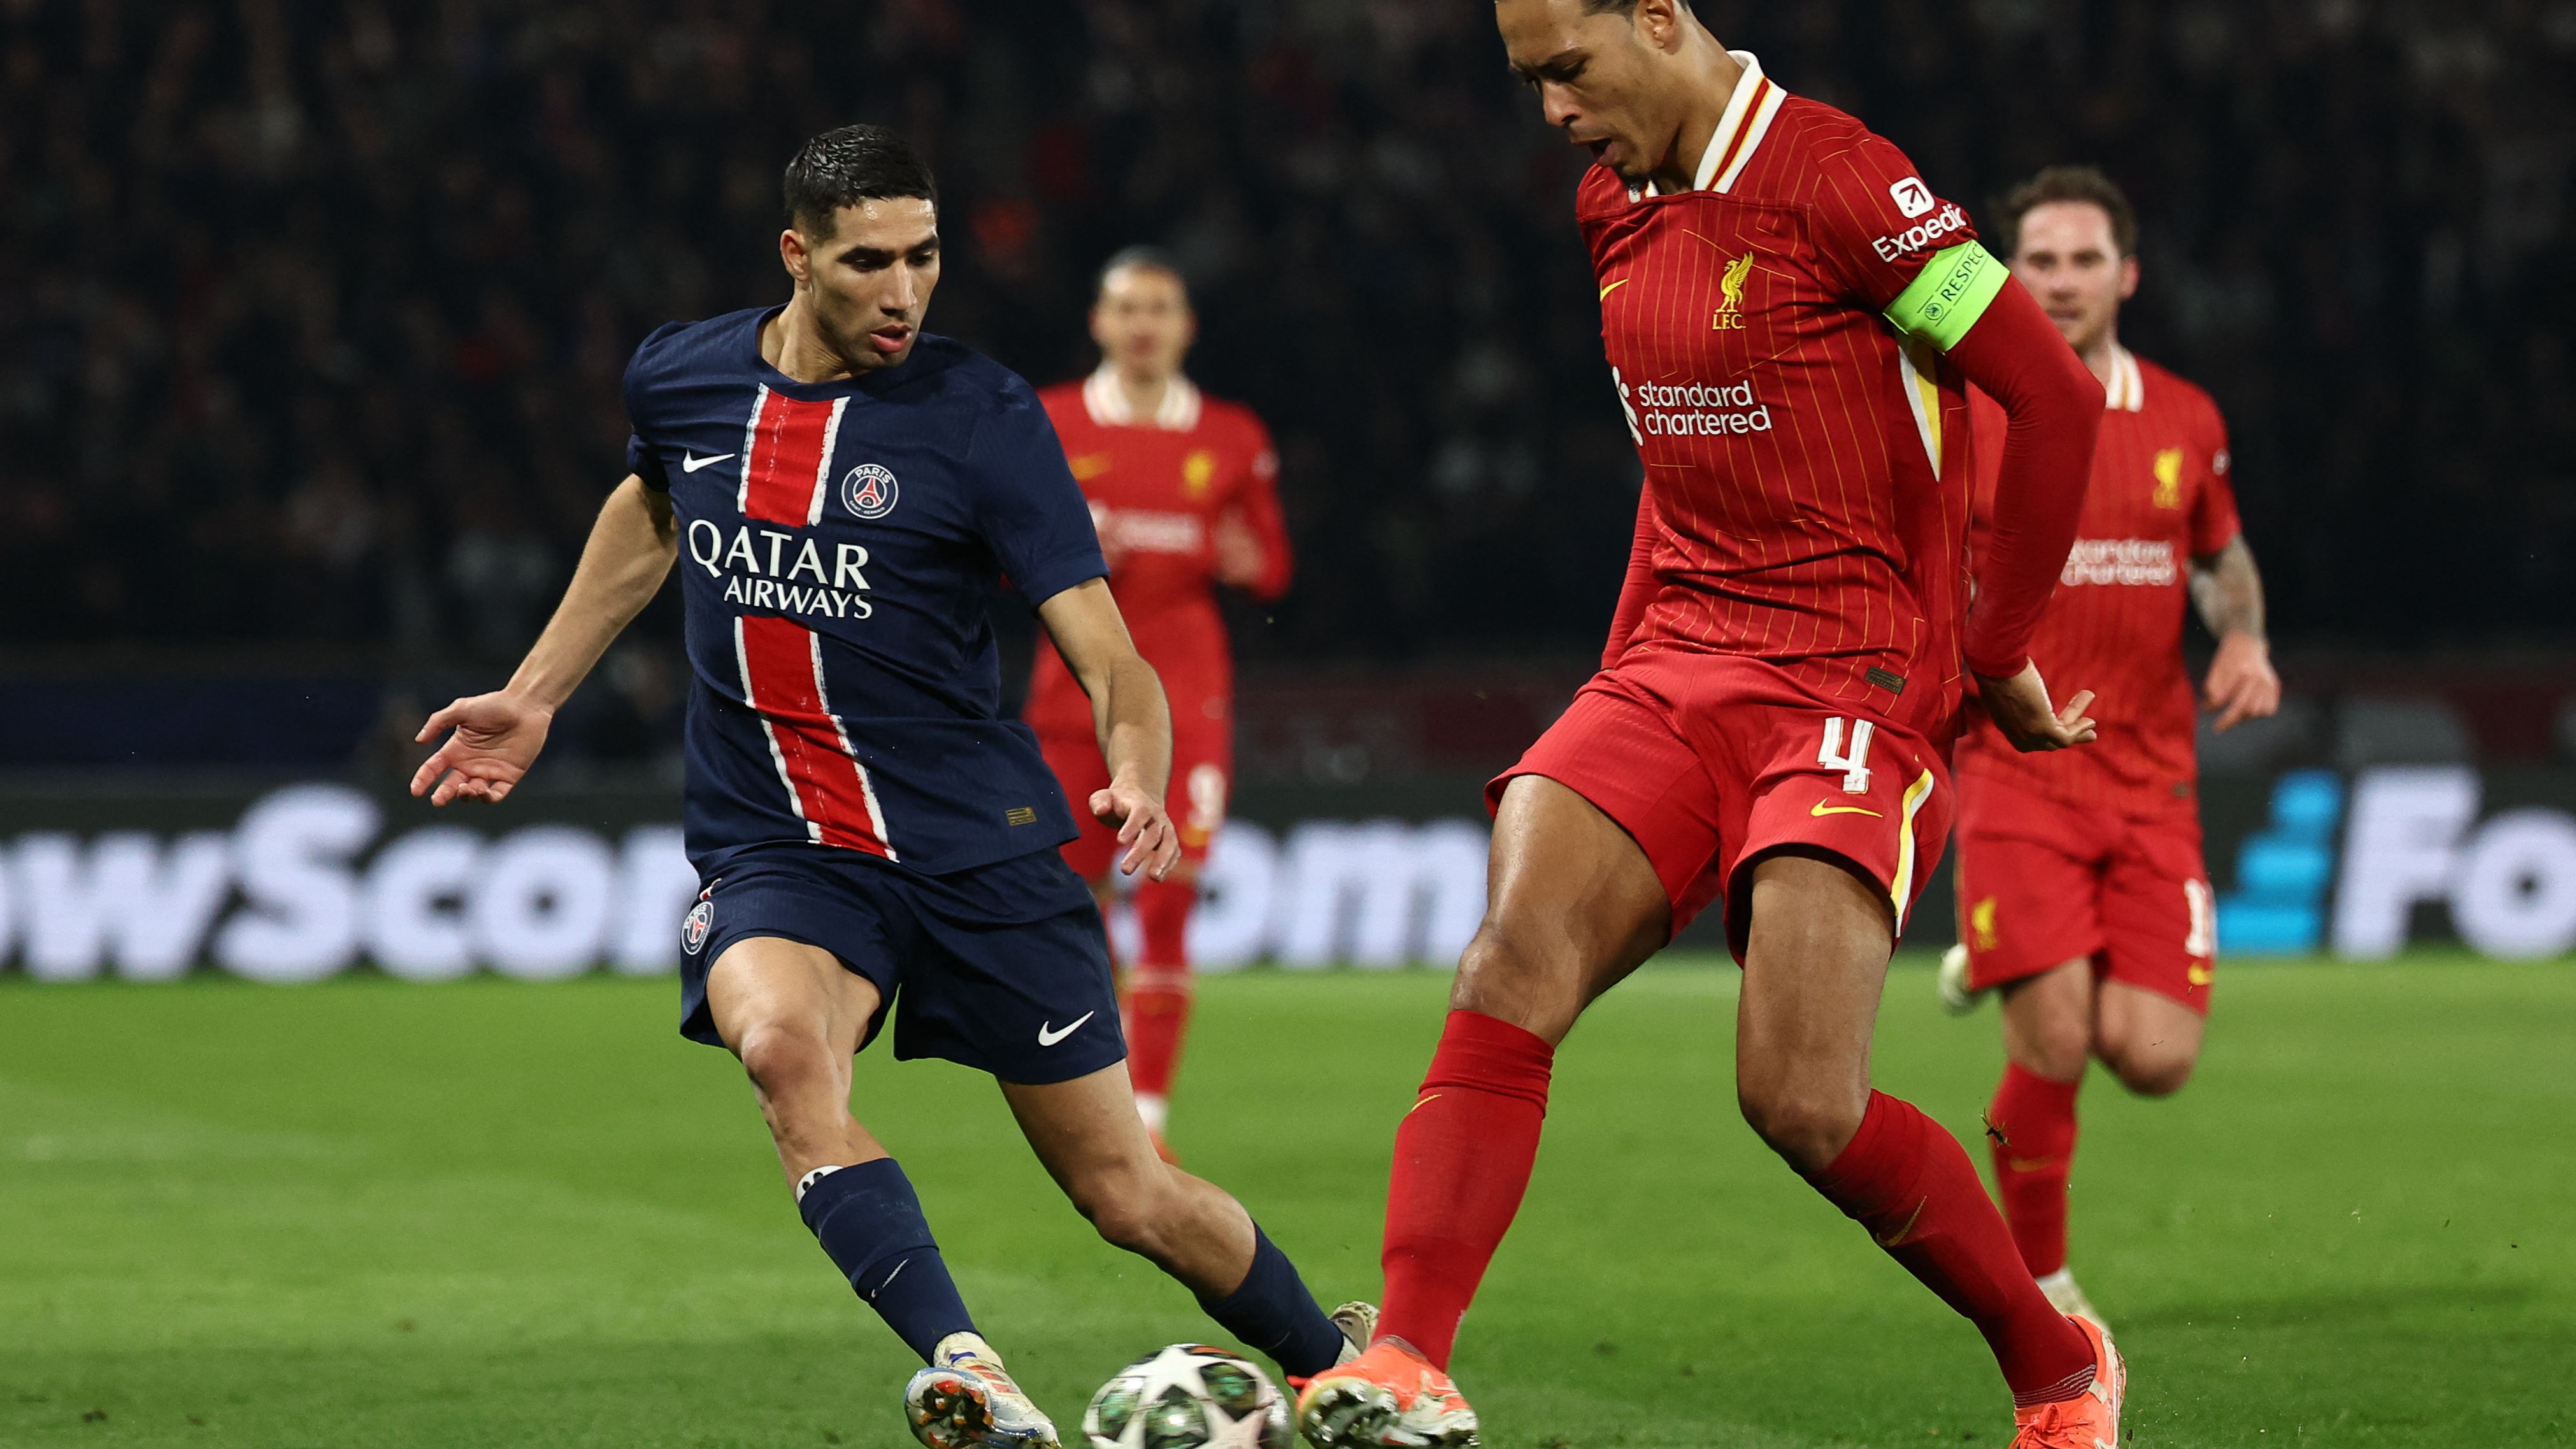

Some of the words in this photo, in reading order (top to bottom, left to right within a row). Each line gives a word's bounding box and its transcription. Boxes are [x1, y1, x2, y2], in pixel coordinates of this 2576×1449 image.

[1638, 380, 1754, 407] standard
[1645, 404, 1772, 435] chartered
[854, 467, 892, 483] PARIS
[688, 519, 871, 590] QATAR
[724, 575, 873, 619] AIRWAYS
[1817, 717, 1875, 794] 4
[683, 904, 707, 929] PARIS
